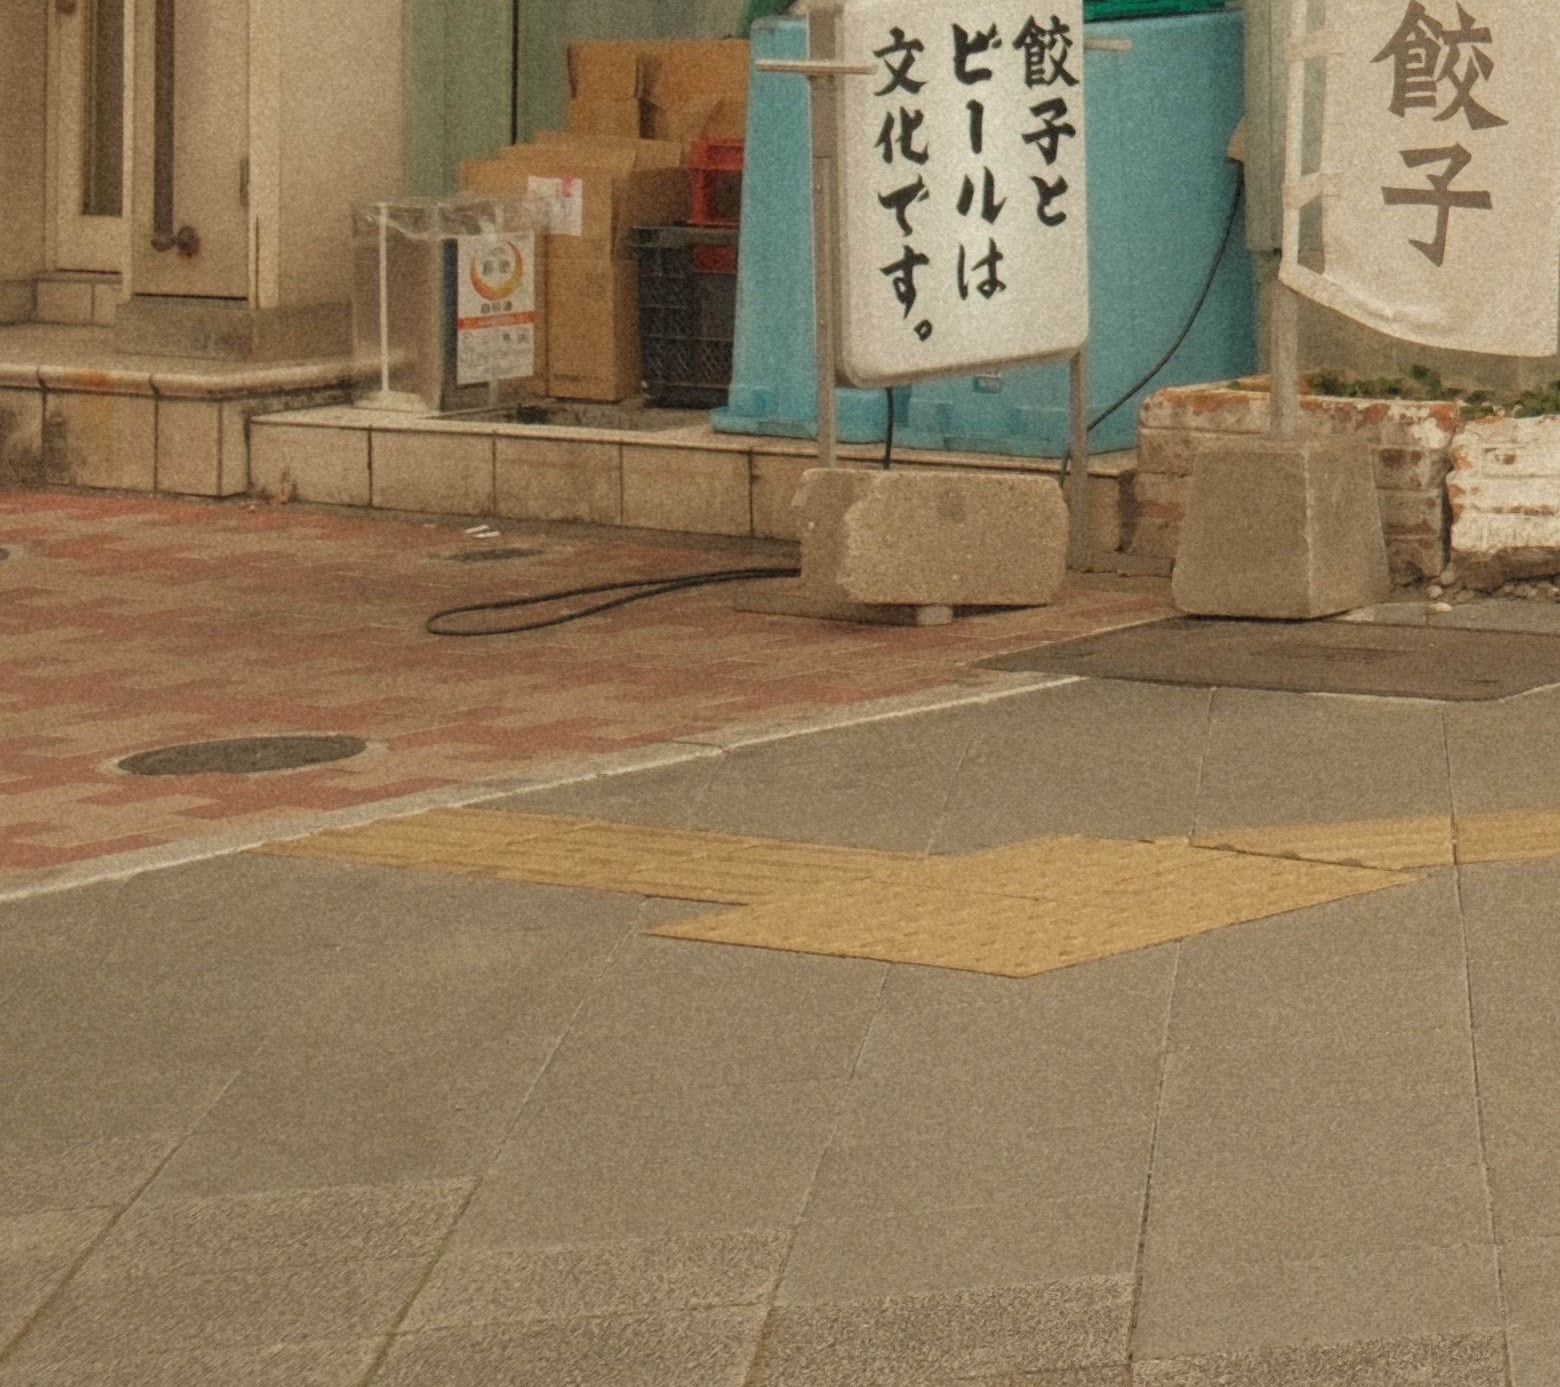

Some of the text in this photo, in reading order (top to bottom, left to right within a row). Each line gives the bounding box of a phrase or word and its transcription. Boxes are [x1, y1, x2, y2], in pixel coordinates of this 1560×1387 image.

[872, 27, 935, 343] 文化です。
[953, 23, 1007, 300] ビールは
[1014, 14, 1079, 227] 餃子と
